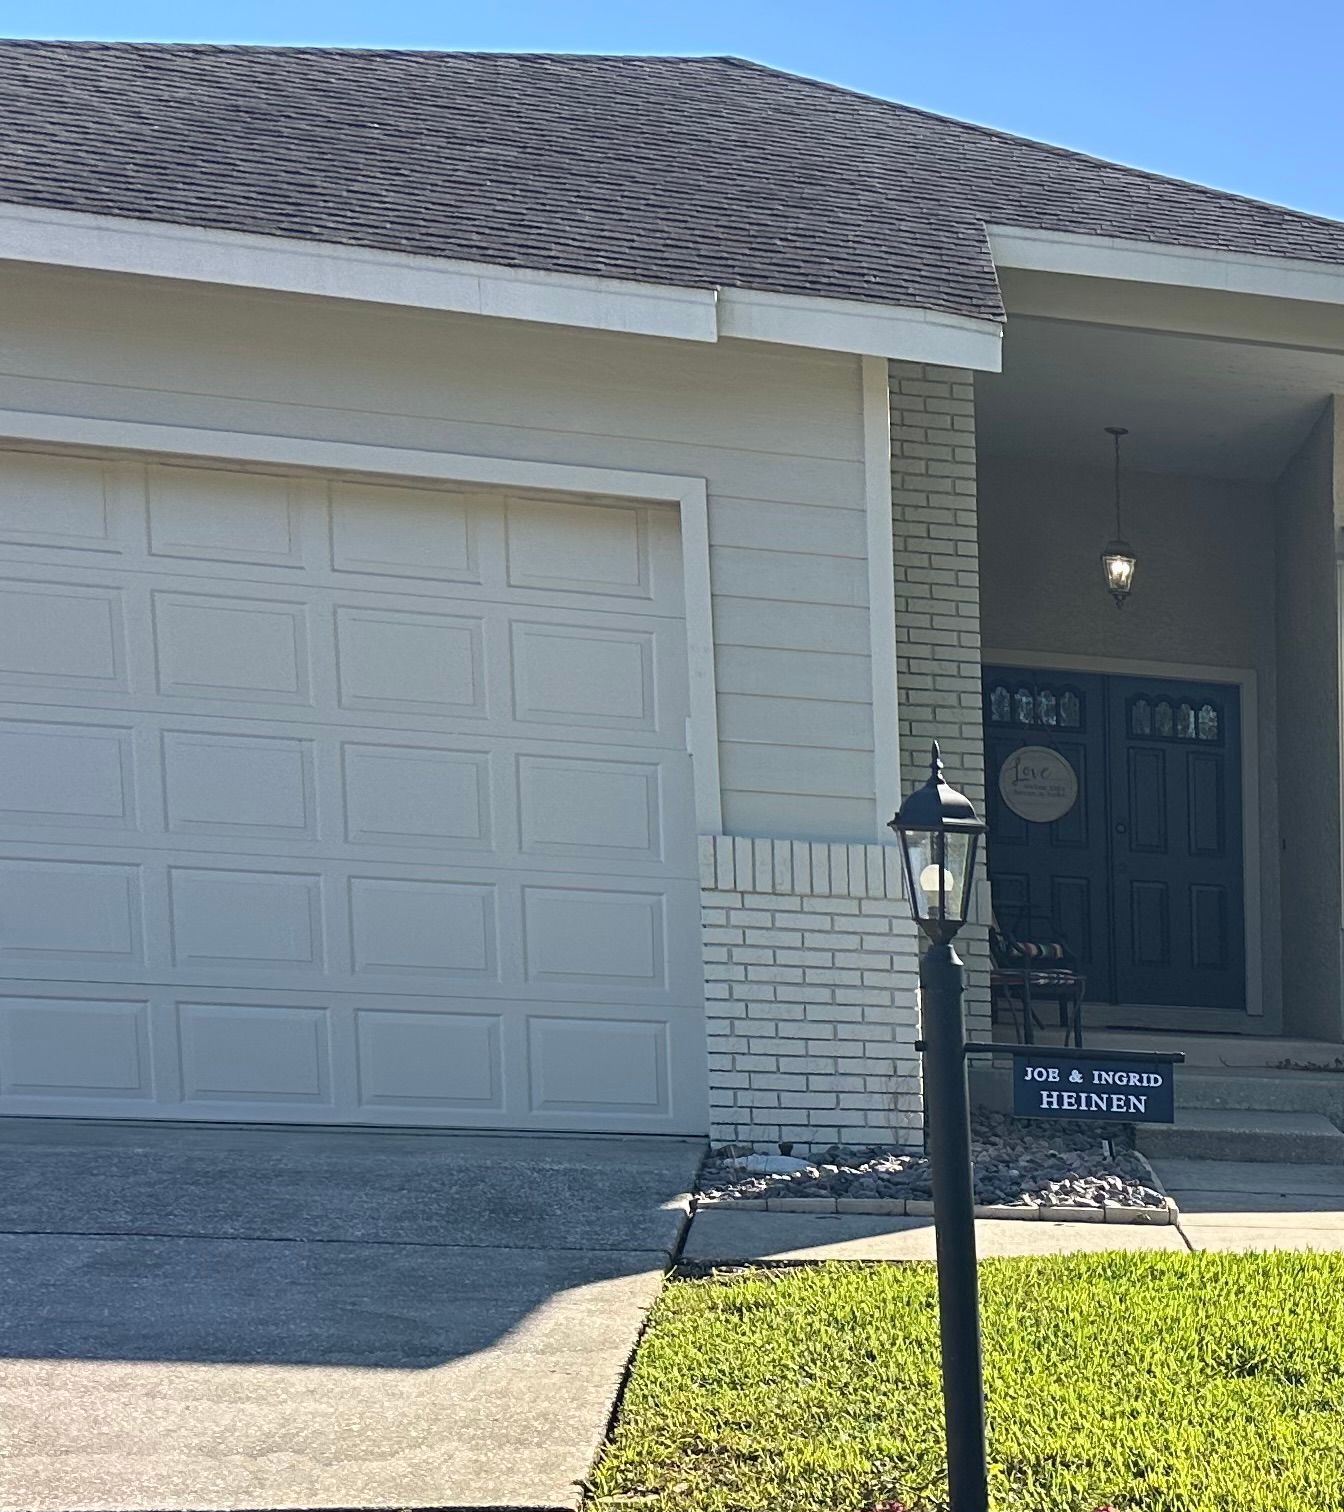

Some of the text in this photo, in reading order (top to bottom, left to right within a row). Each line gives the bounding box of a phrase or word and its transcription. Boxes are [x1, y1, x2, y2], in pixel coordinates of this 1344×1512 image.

[1024, 1067, 1163, 1088] JOE & INGRID
[1040, 1091, 1147, 1114] HEINEN
